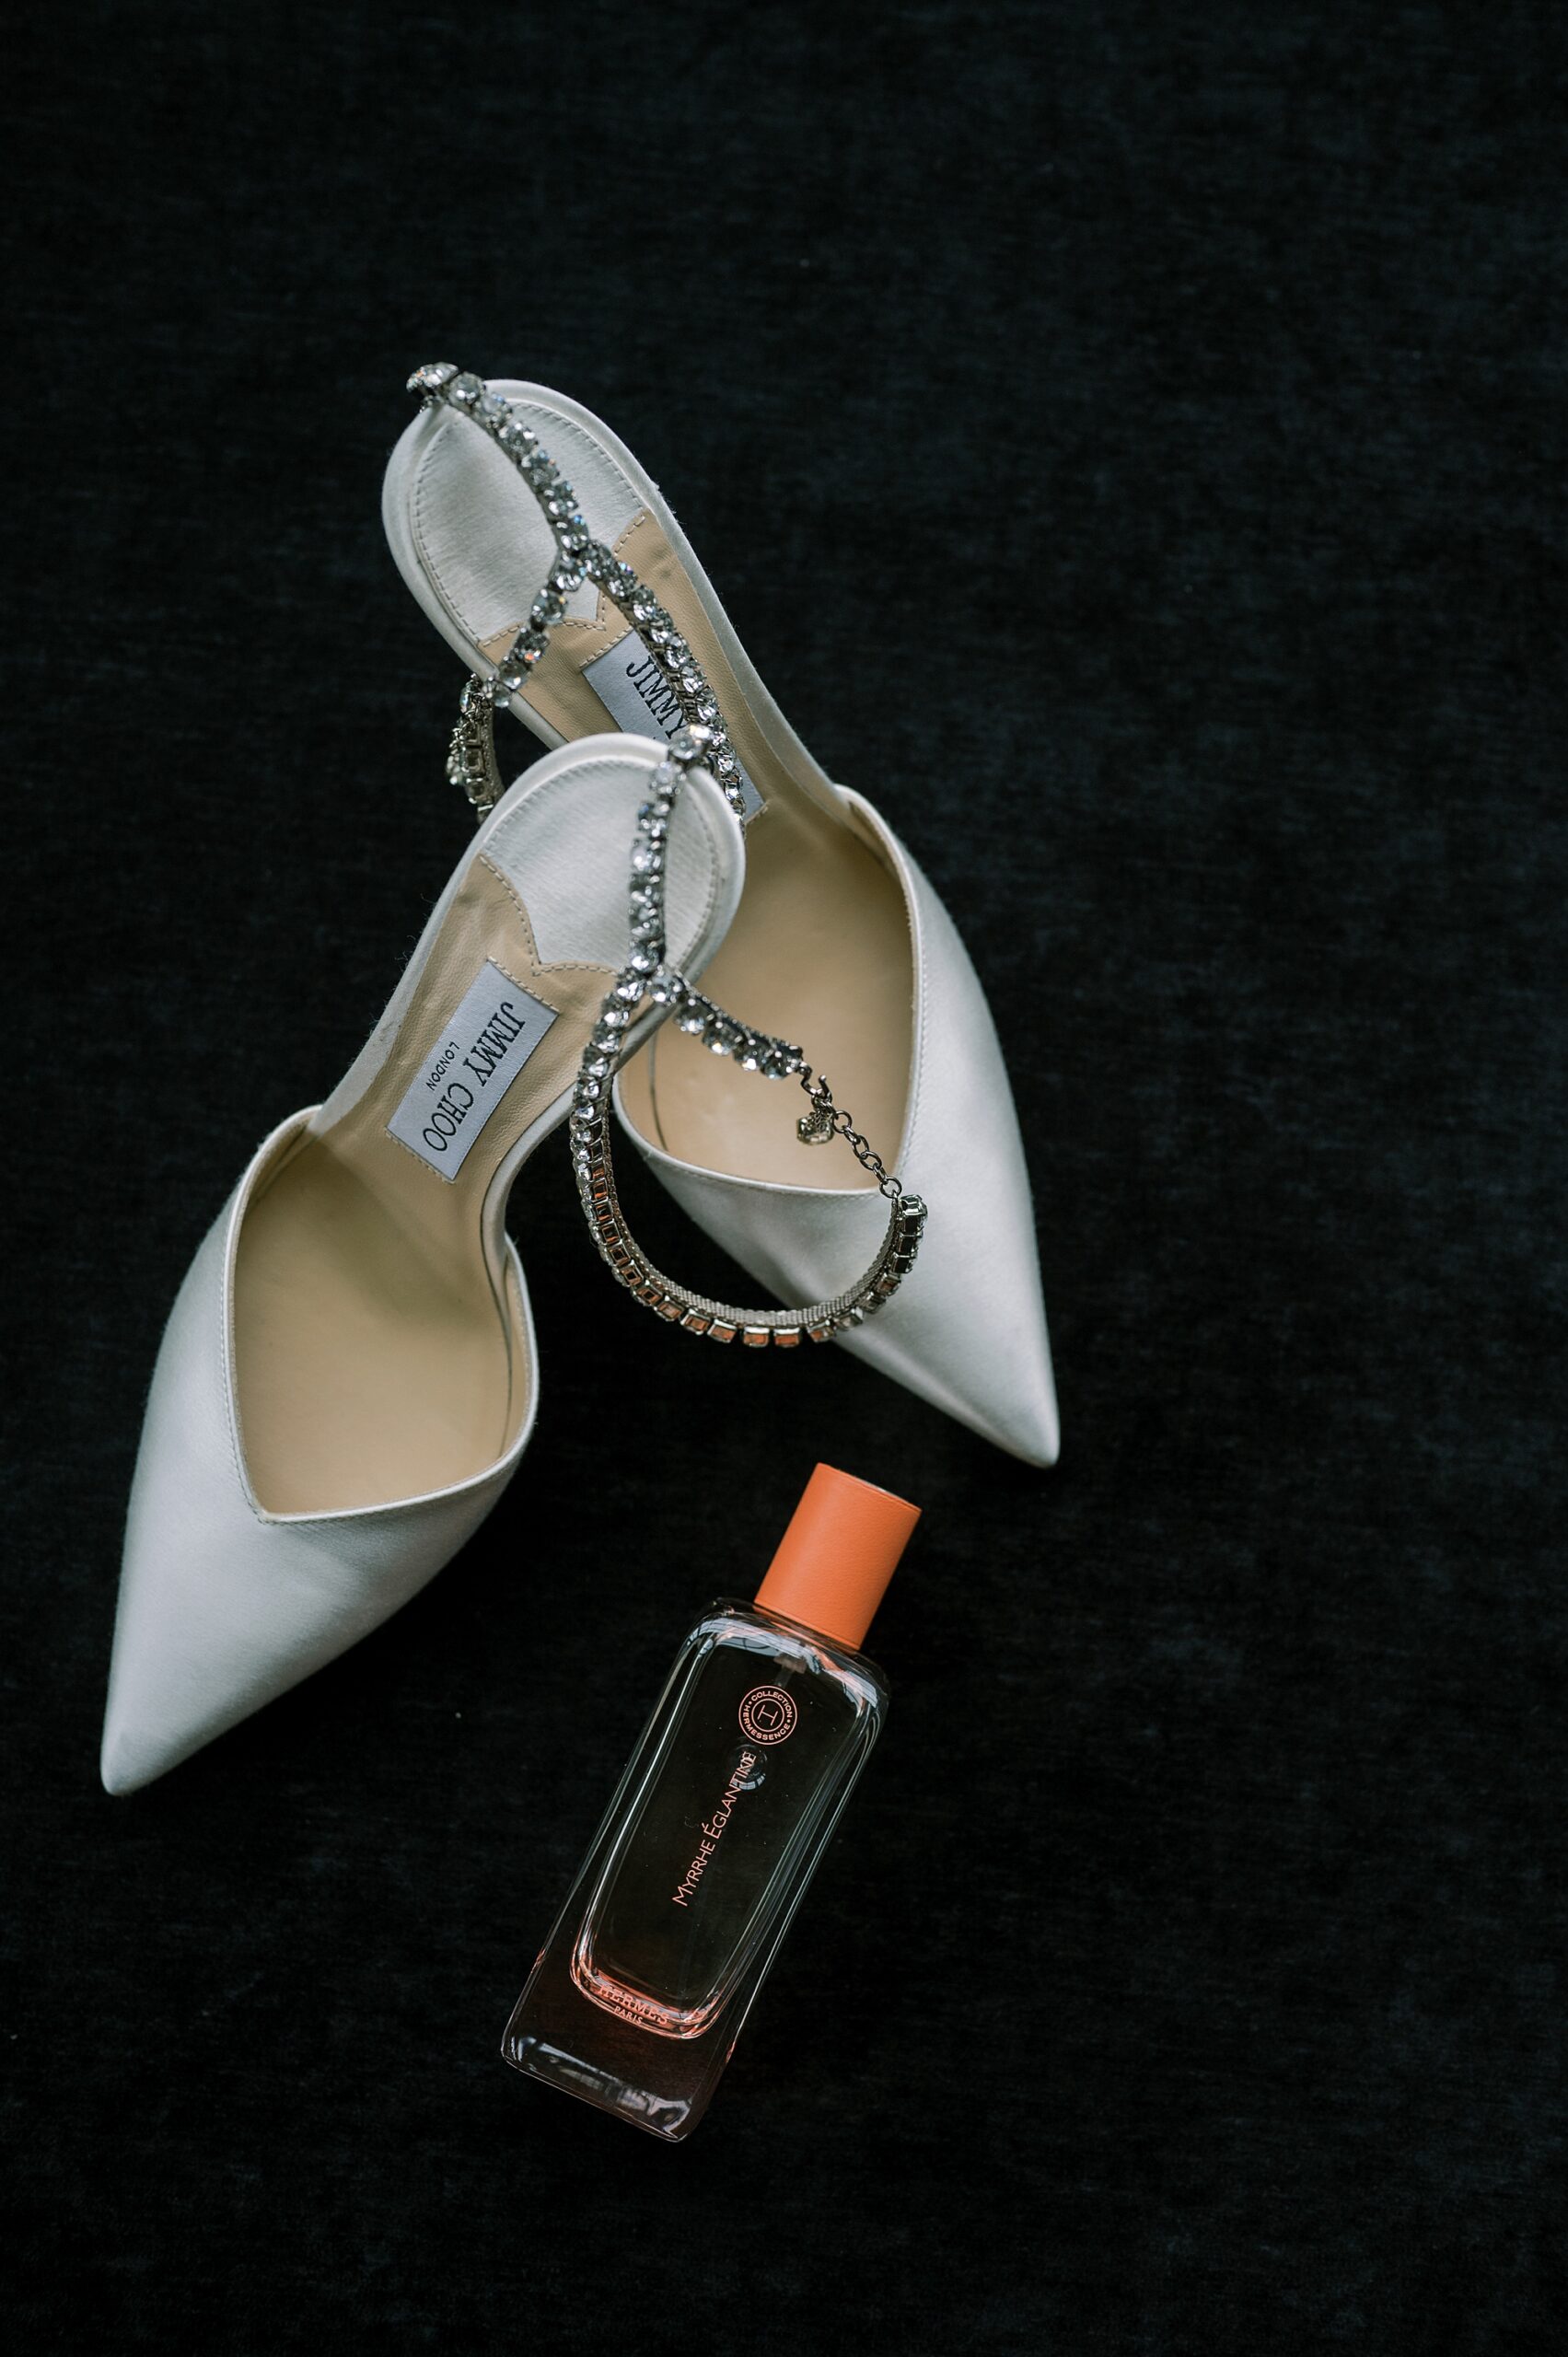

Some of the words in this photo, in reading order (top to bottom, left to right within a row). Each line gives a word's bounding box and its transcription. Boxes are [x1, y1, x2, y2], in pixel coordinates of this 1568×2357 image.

[425, 1041, 460, 1091] LONDON
[462, 1001, 526, 1087] JIMMY
[423, 1082, 474, 1152] CHOO
[742, 1704, 791, 1741] HERMESSENCE
[750, 1690, 793, 1718] COLLECTION
[671, 1840, 716, 1907] MYRRHE
[614, 2006, 644, 2025] PARIS
